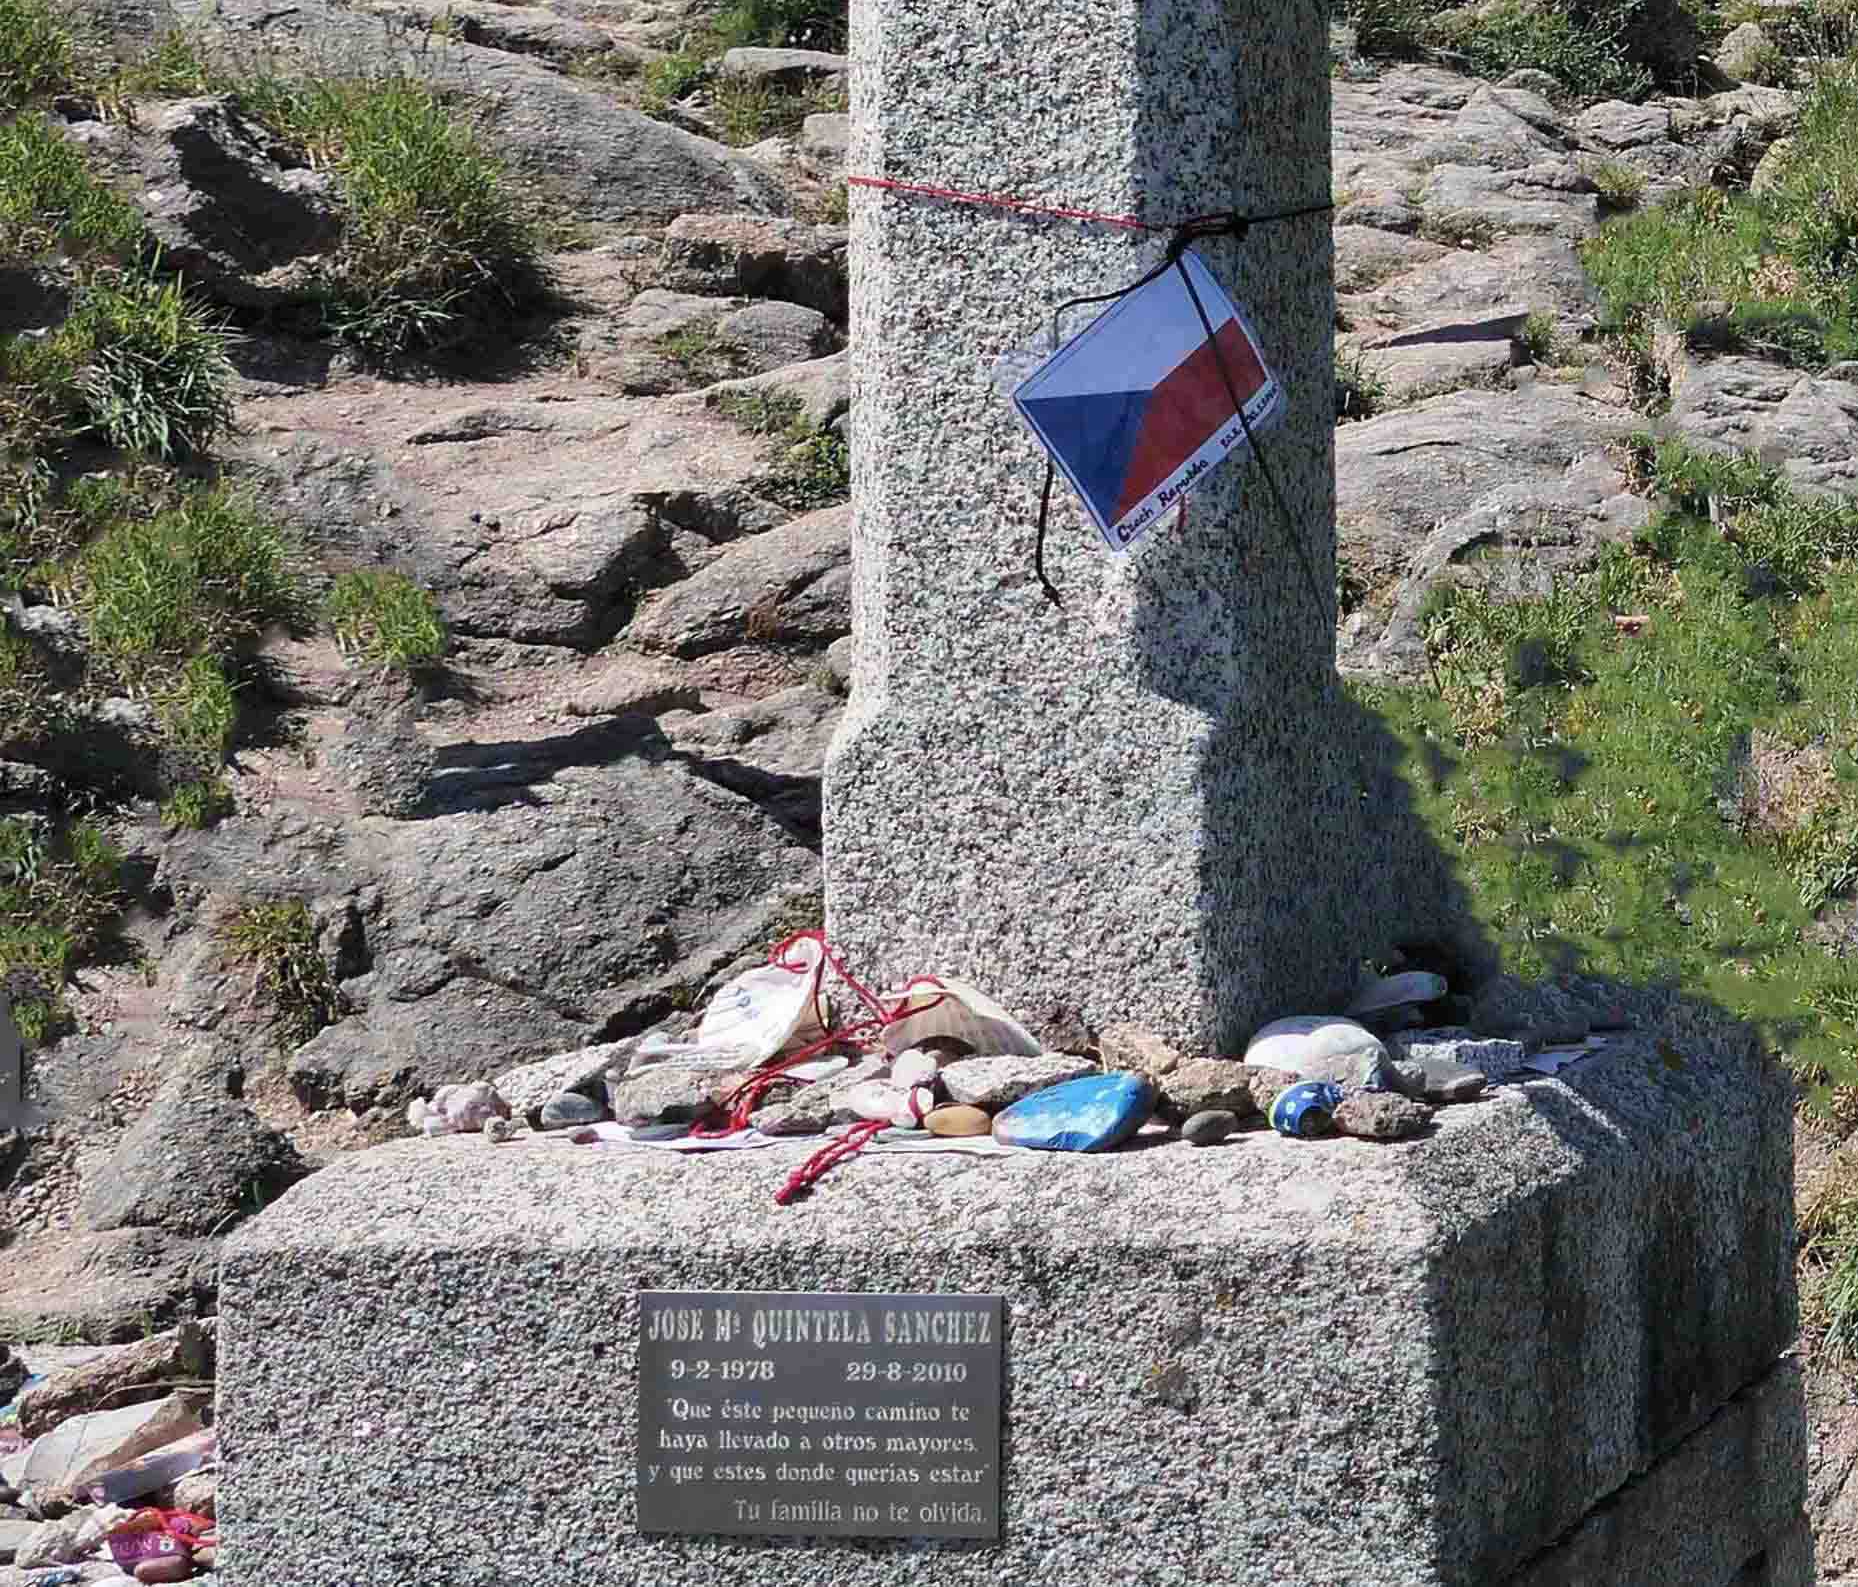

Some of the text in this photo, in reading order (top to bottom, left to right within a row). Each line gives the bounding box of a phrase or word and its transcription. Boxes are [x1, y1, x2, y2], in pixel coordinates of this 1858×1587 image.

[752, 1308, 872, 1350] QUINTELA
[883, 1310, 992, 1345] SANCHEZ
[670, 1359, 968, 1382] 9-2-1978 29-8-2010
[721, 1398, 762, 1419] éste
[772, 1404, 855, 1424] pequeño
[864, 1403, 941, 1421] camino
[952, 1405, 970, 1422] te
[658, 1429, 709, 1450] haya
[718, 1429, 790, 1451] llevado
[799, 1435, 812, 1451] a
[822, 1433, 877, 1451] otros
[647, 1463, 661, 1484] y
[670, 1463, 704, 1484] que
[775, 1463, 835, 1482] donde
[734, 1499, 988, 1523] Tu familia no te olvida.
